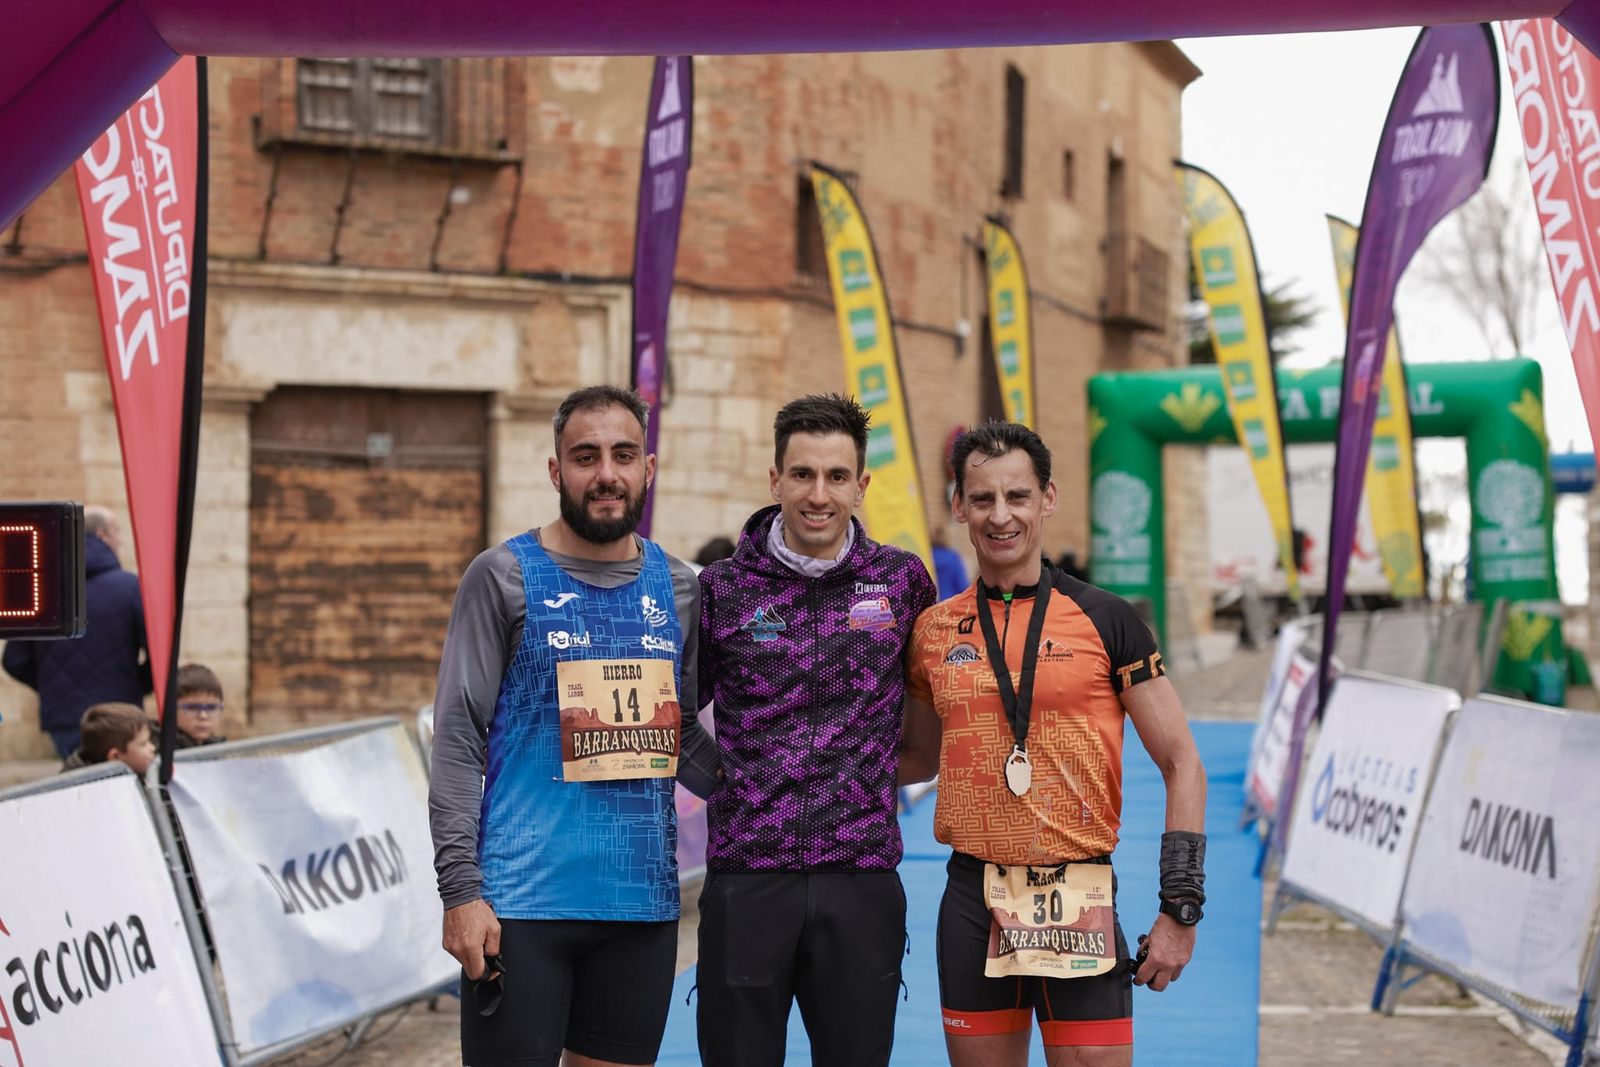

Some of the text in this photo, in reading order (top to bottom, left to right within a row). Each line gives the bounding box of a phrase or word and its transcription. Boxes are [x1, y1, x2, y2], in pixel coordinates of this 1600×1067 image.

[602, 664, 643, 681] HIERRO
[612, 687, 641, 723] 14
[573, 728, 676, 758] BARRANQUERAS
[948, 767, 975, 778] TRZ
[1459, 796, 1558, 880] DAKONA
[1033, 888, 1063, 925] 30
[998, 928, 1105, 956] BARRANQUERAS
[6, 911, 157, 1026] acciona
